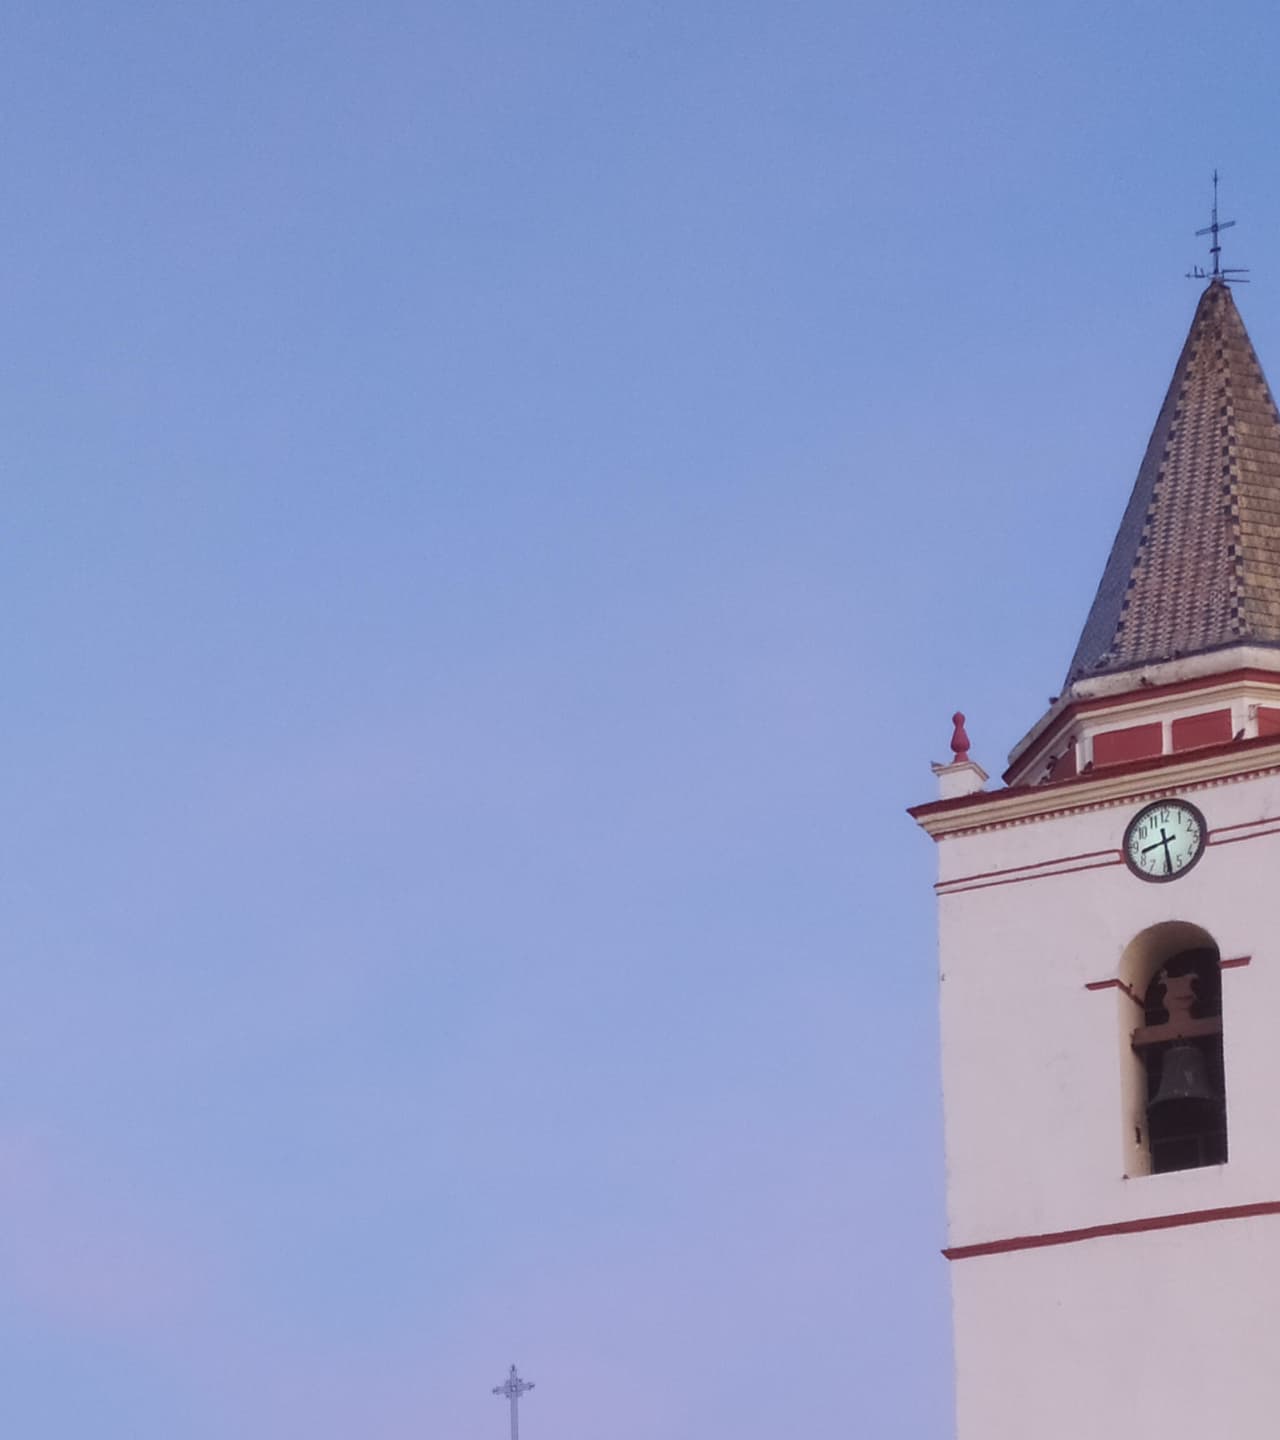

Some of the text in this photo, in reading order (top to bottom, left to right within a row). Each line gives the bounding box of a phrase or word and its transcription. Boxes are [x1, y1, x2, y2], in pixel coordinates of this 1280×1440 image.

[1150, 815, 1158, 829] 11
[1160, 811, 1170, 823] 12
[1177, 812, 1181, 824] 1
[1186, 819, 1193, 832] 2
[1138, 827, 1148, 840] 10
[1193, 832, 1198, 844] 3
[1133, 842, 1139, 854] 9
[1187, 844, 1193, 857] 4
[1140, 853, 1147, 866] 8
[1149, 859, 1156, 872] 7
[1176, 854, 1183, 868] 5
